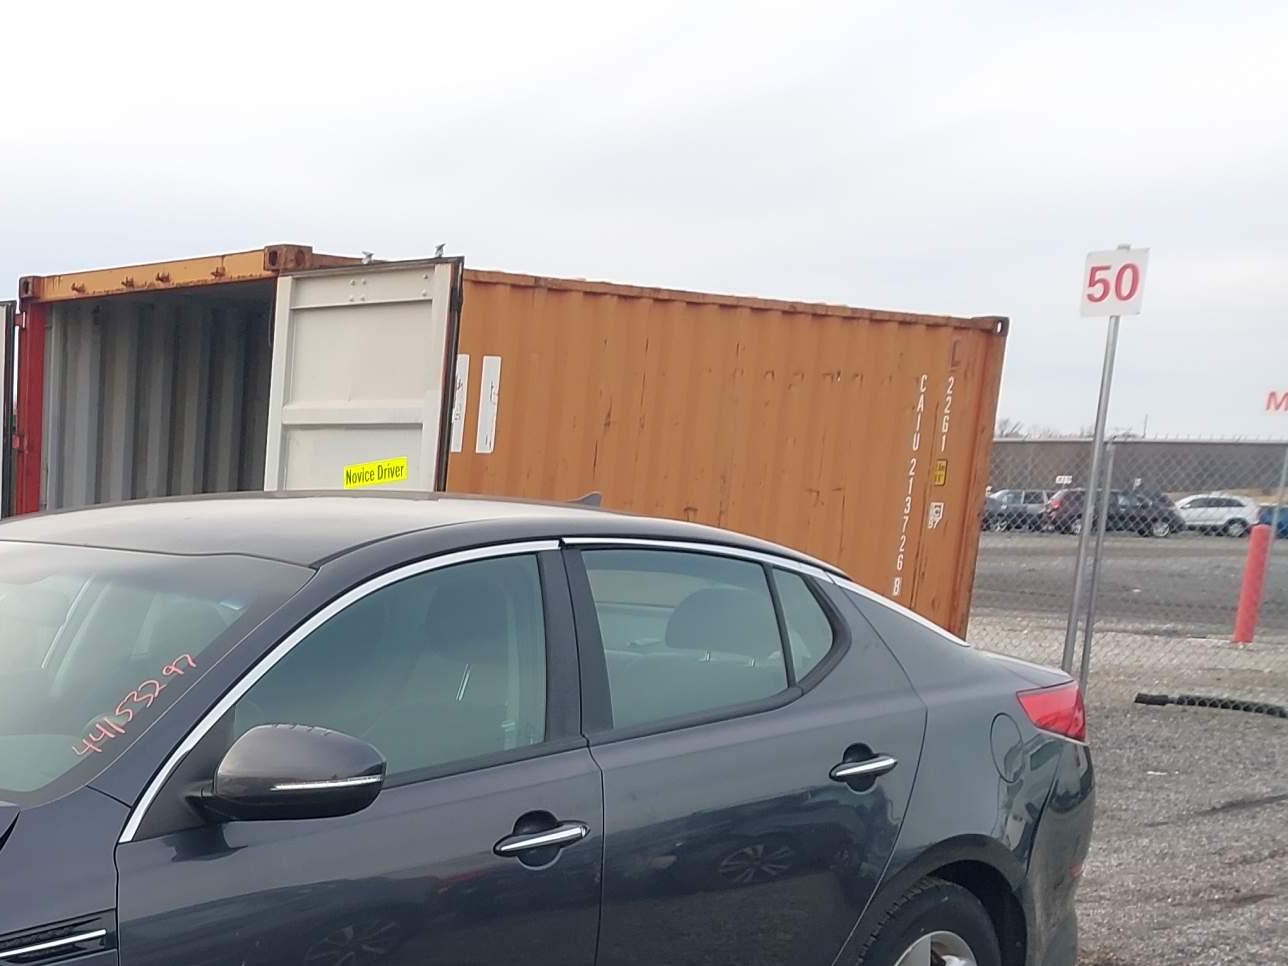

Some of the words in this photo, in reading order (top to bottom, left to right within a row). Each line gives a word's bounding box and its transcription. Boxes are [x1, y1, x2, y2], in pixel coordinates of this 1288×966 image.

[1086, 262, 1140, 303] 50
[912, 374, 928, 451] CAIU
[345, 467, 375, 486] Novice
[377, 462, 405, 481] Driver
